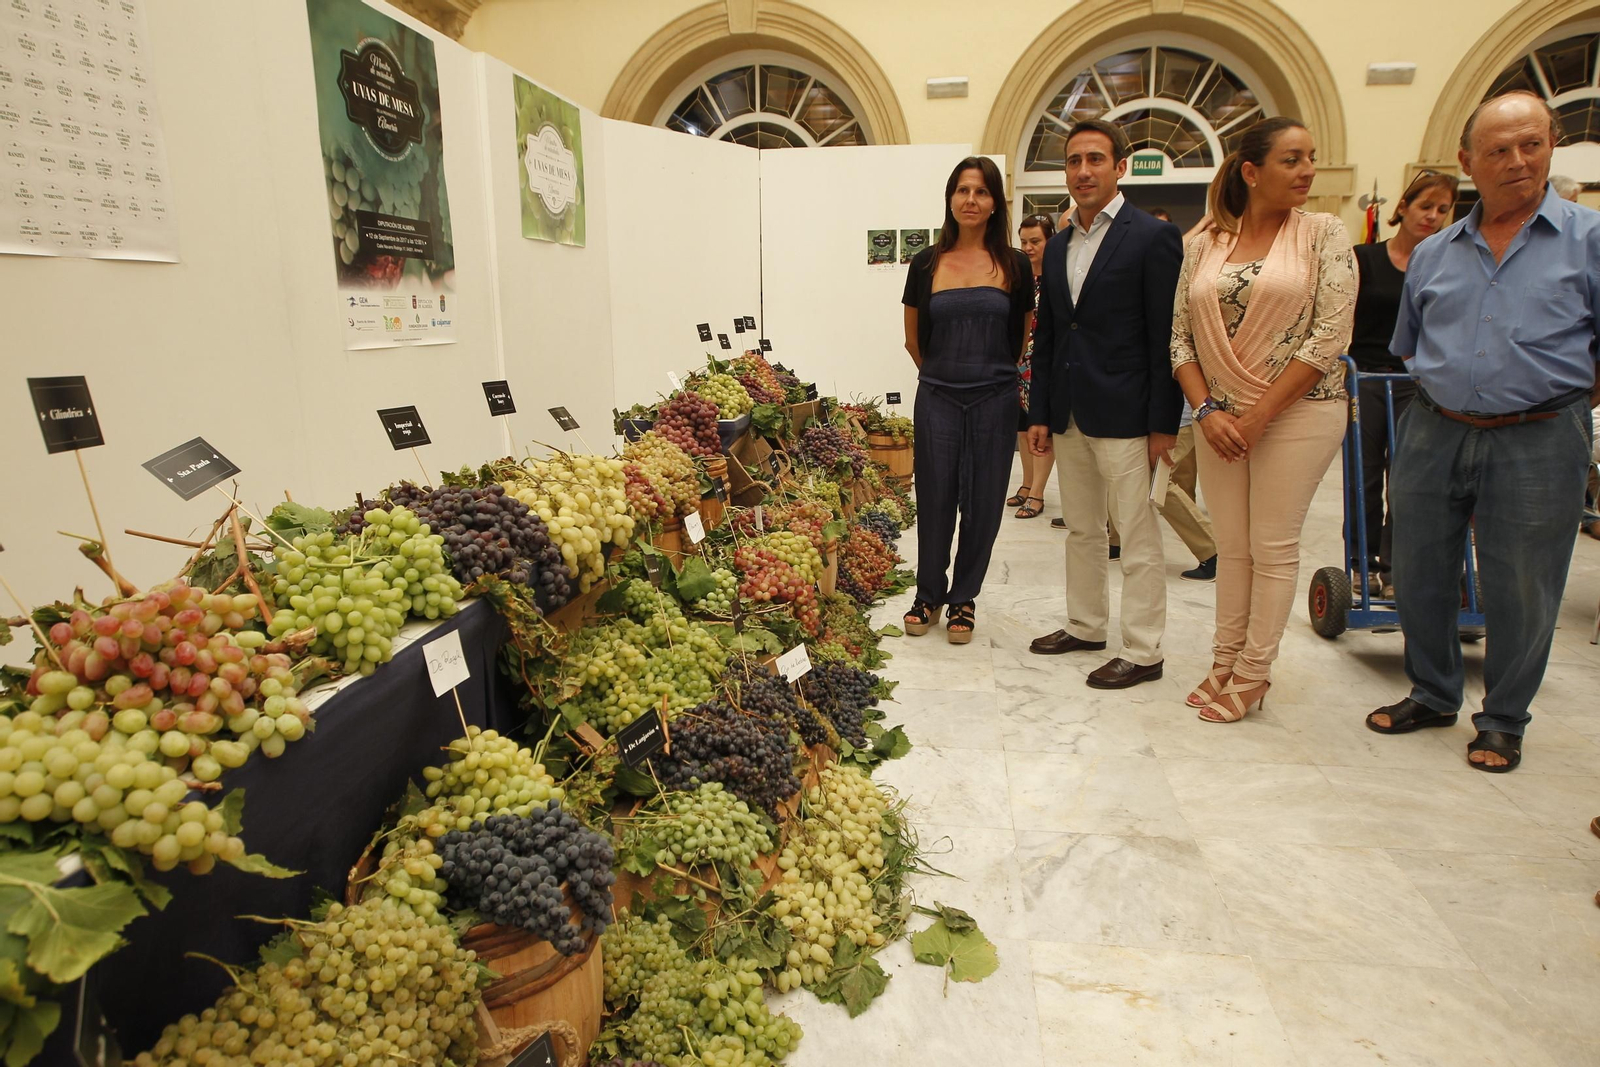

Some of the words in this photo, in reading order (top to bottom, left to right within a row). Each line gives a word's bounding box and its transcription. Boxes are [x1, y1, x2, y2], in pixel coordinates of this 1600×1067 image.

[353, 81, 377, 102] UVAS
[379, 91, 391, 108] DE
[392, 96, 414, 118] MESA
[1134, 161, 1161, 170] SALIDA
[176, 468, 193, 478] Sta.
[189, 459, 210, 471] Paula
